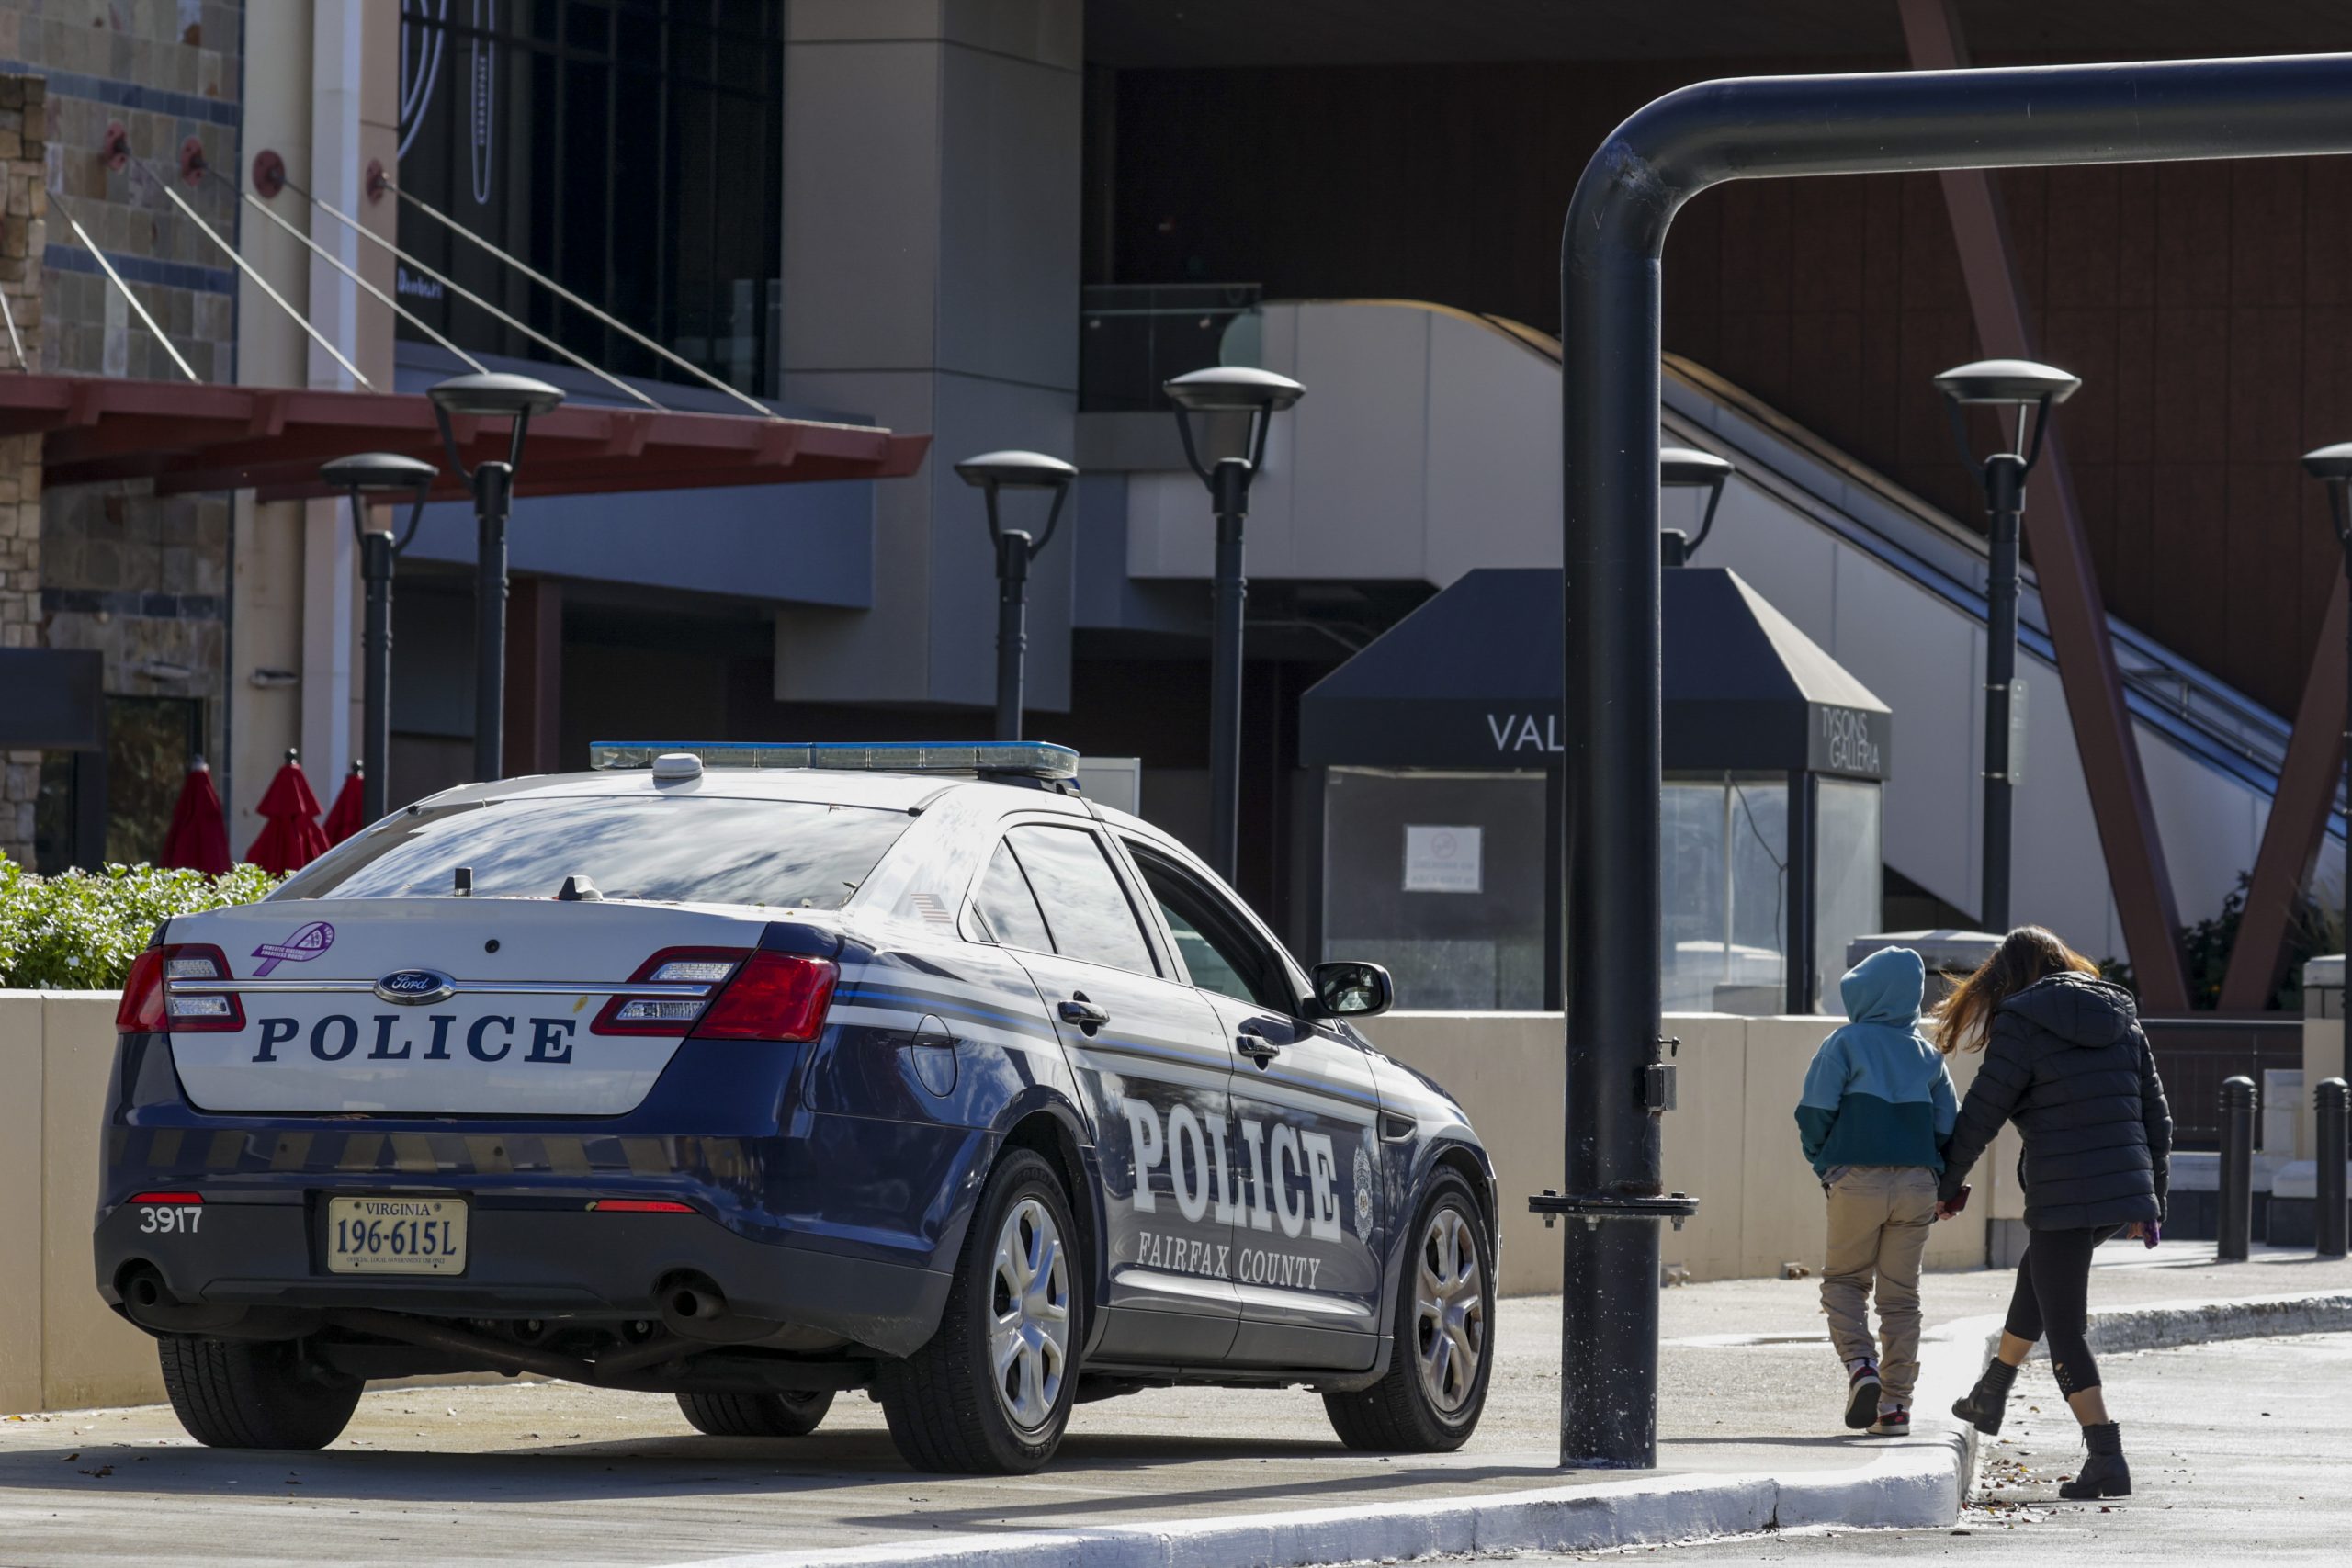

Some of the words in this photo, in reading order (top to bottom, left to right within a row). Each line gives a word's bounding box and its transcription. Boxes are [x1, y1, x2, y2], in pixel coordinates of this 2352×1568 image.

[1487, 714, 1565, 751] VAL
[1822, 706, 1867, 741] TYSONS
[1830, 736, 1881, 773] GALLERIA
[391, 974, 429, 989] Ford
[252, 1014, 577, 1064] POLICE
[1123, 1098, 1342, 1243] POLICE
[140, 1207, 202, 1233] 3917
[366, 1203, 431, 1216] VIRGINIA
[337, 1218, 457, 1255] 196-615L
[1136, 1231, 1231, 1279] FAIRFAX
[1239, 1247, 1321, 1290] COUNTY
